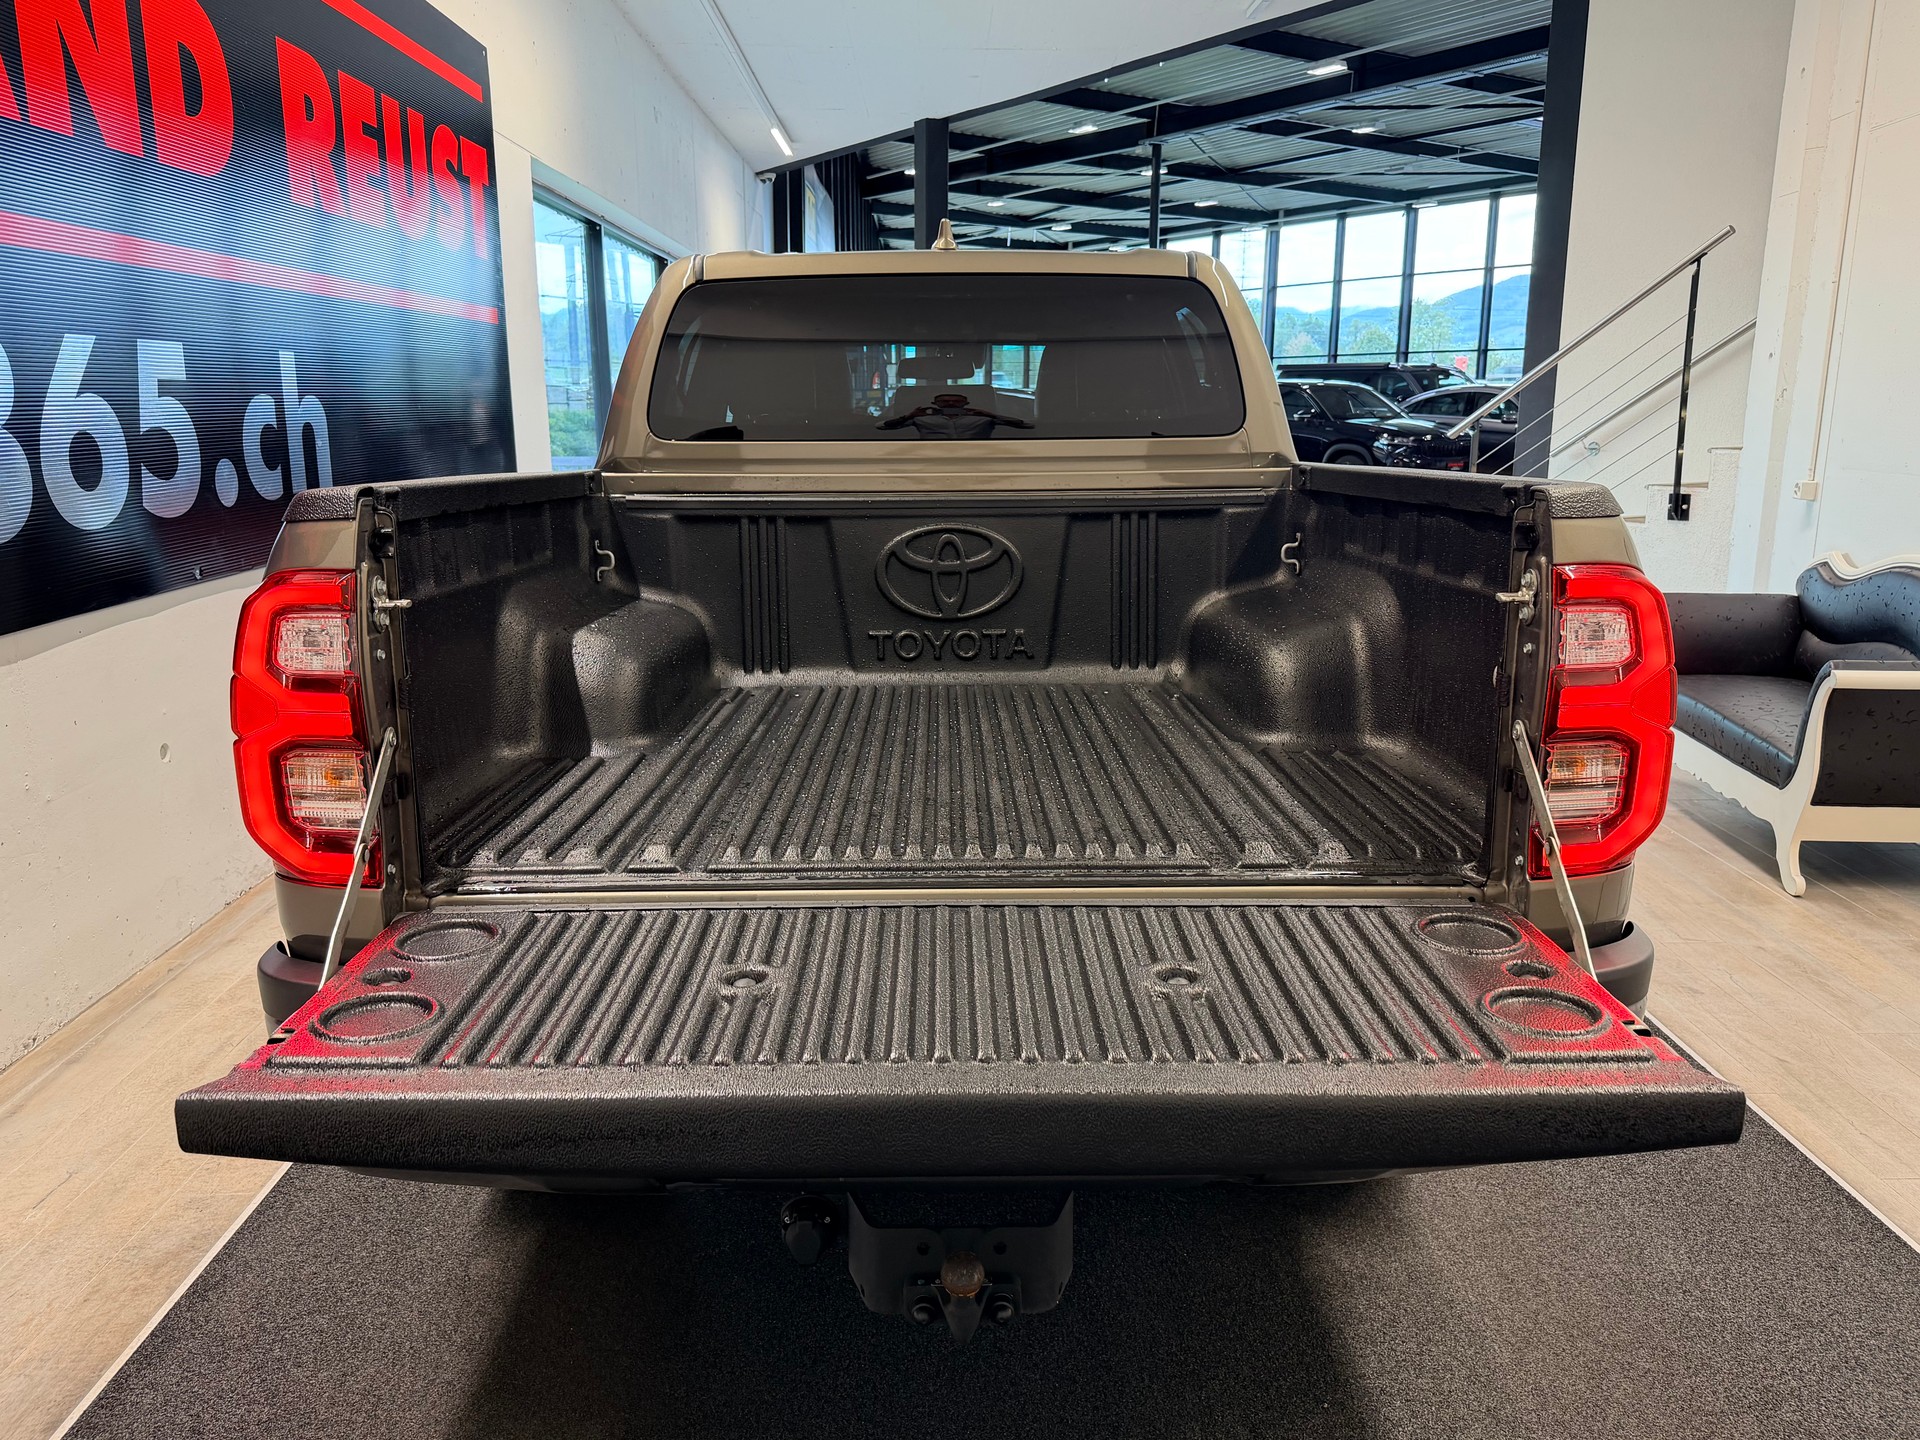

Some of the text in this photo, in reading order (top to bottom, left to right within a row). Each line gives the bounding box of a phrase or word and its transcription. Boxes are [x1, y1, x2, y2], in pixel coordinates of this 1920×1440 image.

[0, 0, 489, 260] ND REUST
[868, 629, 1035, 660] TOYOTA
